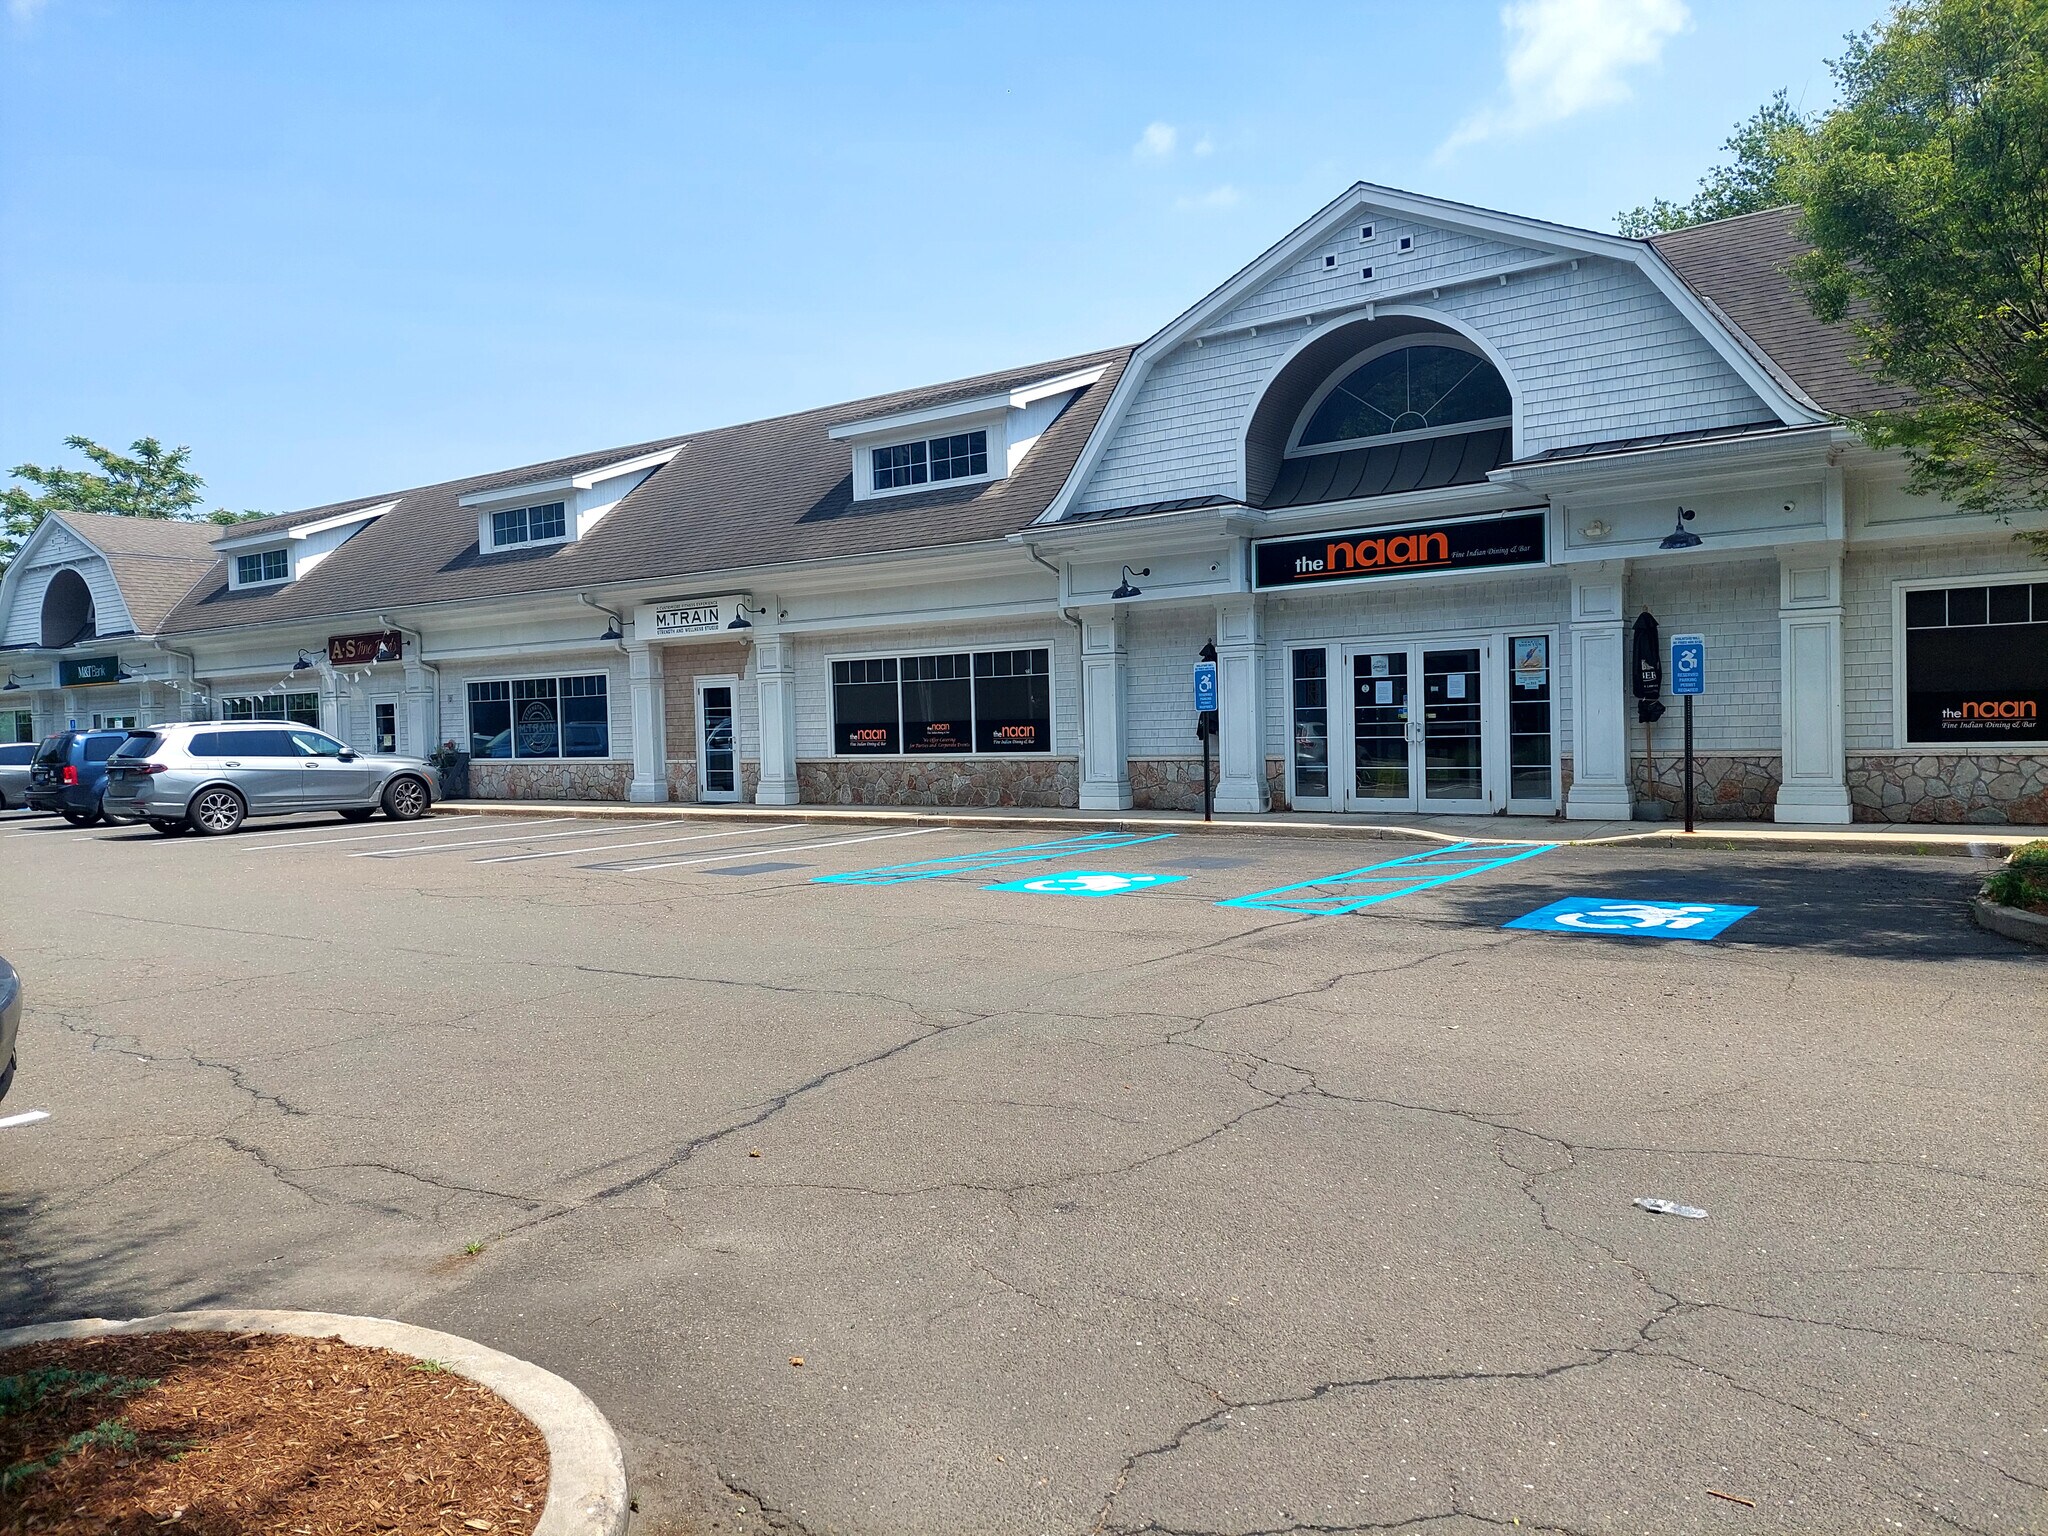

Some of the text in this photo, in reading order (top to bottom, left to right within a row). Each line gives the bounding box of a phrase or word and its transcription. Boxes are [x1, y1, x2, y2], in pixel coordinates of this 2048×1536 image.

[1295, 532, 1448, 572] the naan
[1466, 548, 1486, 556] Indian
[1487, 547, 1508, 556] Dining
[656, 608, 718, 626] M.TRAIN
[78, 664, 106, 678] M&T Bank
[1942, 700, 2037, 718] the naan
[1960, 720, 1983, 728] Indian
[1985, 721, 2011, 730] Dining
[857, 729, 886, 740] naan
[1002, 726, 1034, 737] naan
